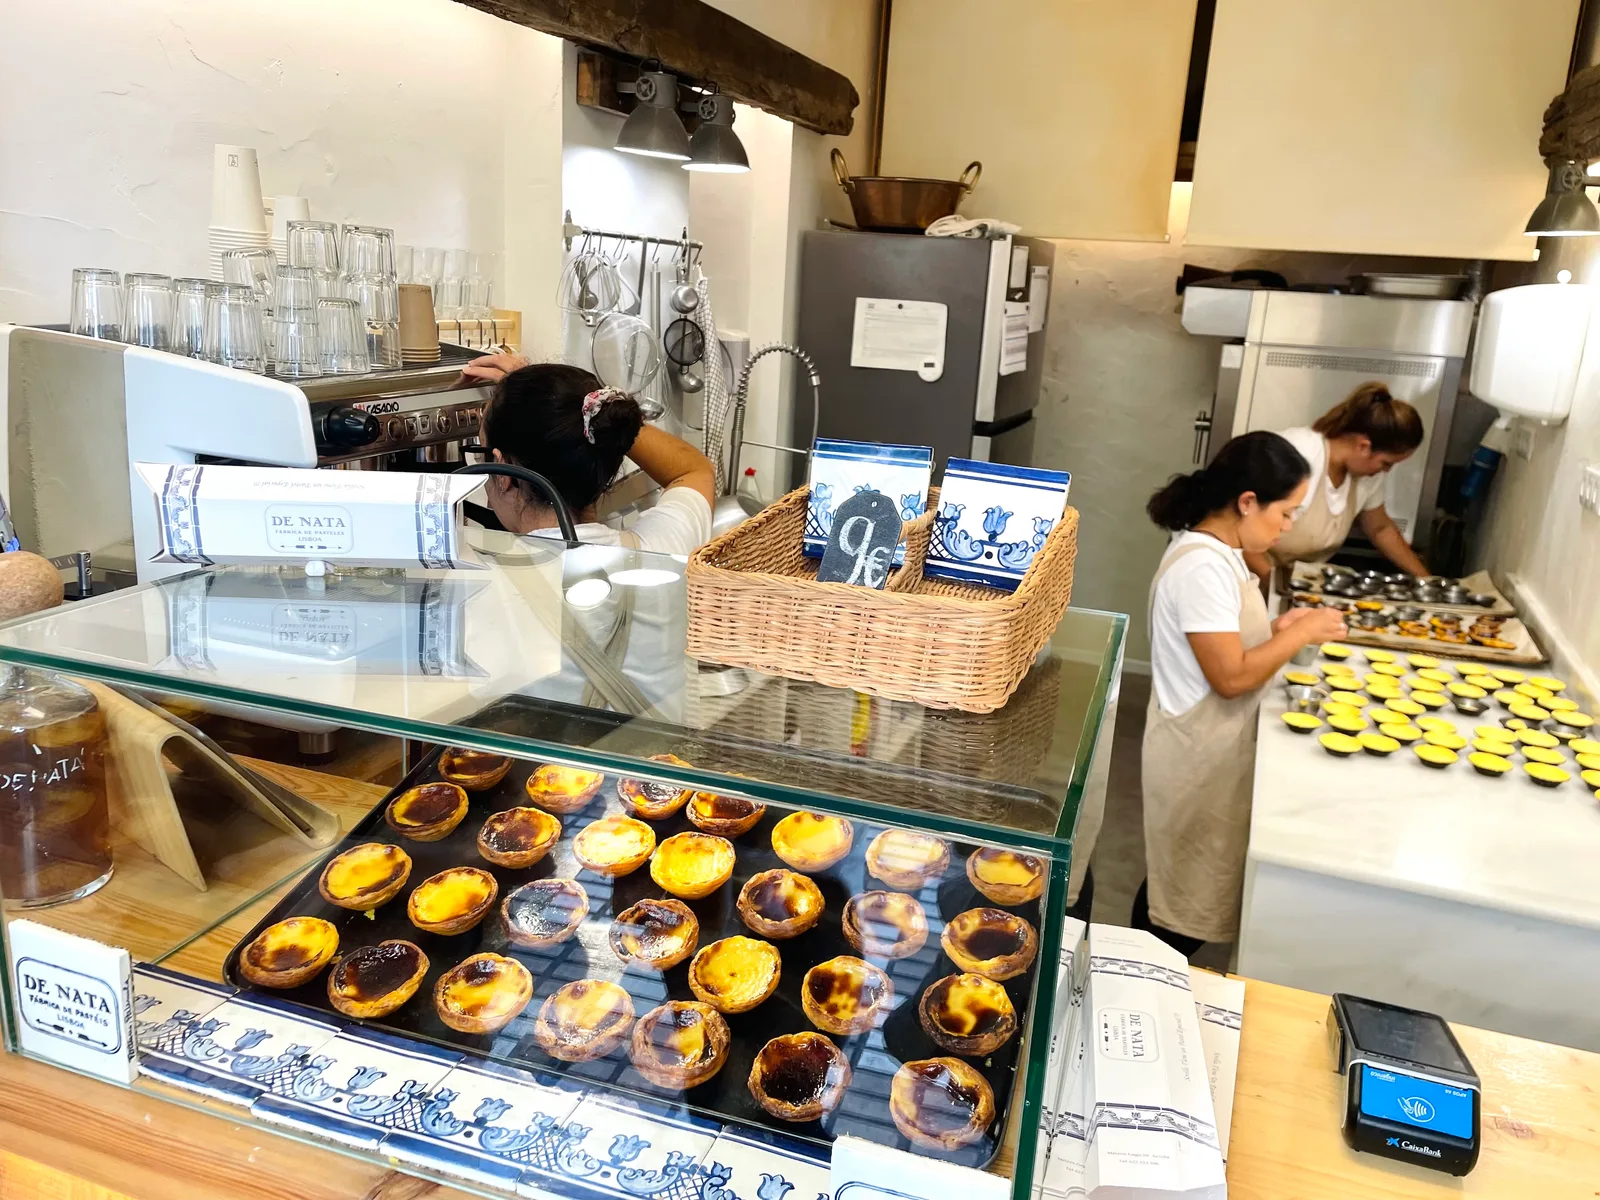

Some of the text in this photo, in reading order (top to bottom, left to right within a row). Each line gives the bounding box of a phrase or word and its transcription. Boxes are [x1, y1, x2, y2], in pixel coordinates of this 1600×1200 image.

[366, 401, 400, 414] CASADIO
[271, 516, 346, 528] DE NATA
[24, 974, 111, 1014] DE NATA
[57, 1014, 84, 1030] LISBOA
[1129, 1013, 1144, 1057] DE NATA
[1401, 1140, 1442, 1158] CaixaBank
